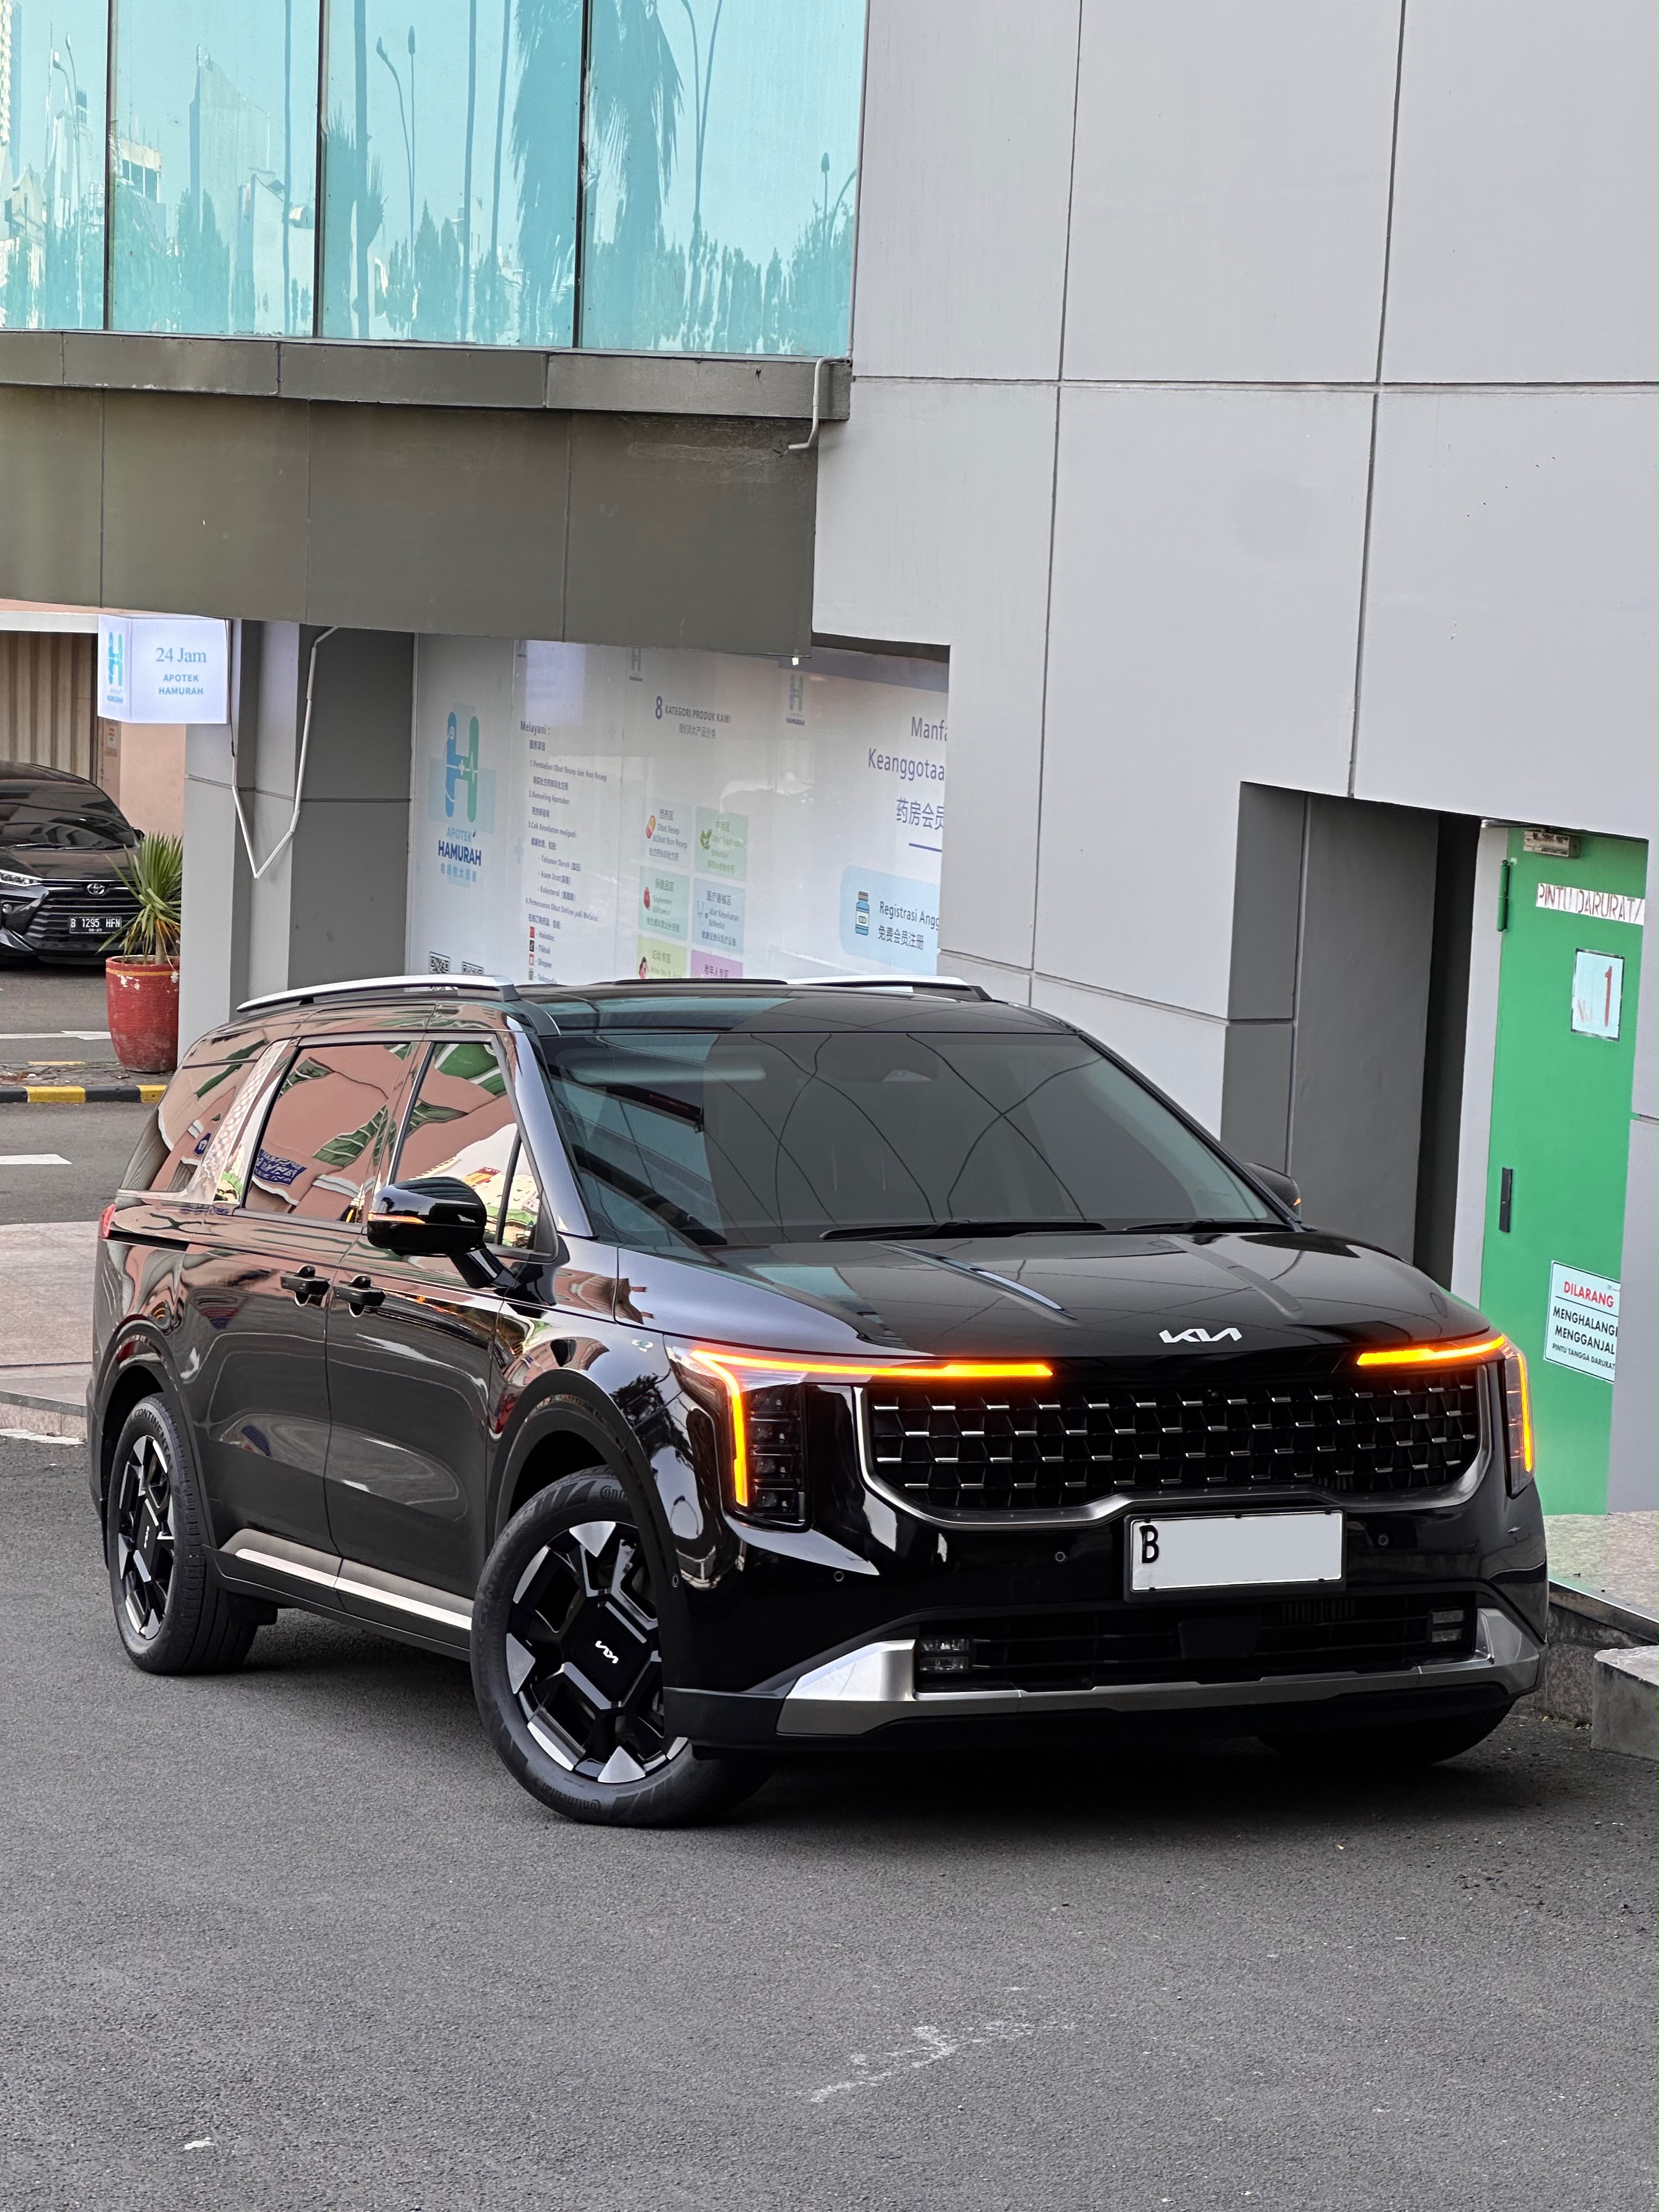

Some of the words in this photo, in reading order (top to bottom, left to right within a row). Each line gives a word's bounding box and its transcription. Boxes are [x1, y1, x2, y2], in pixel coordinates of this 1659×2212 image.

[155, 648, 173, 662] 24
[177, 648, 207, 662] Jam
[163, 674, 199, 682] APOTEK
[655, 695, 662, 719] 8
[664, 705, 691, 718] KATEGORI
[692, 709, 716, 722] PRODUK
[717, 713, 731, 724] KAMI
[520, 721, 546, 735] Melayani
[868, 748, 944, 781] Keanggotaa
[896, 797, 944, 830] 药房会员
[446, 827, 472, 842] APOTEK
[438, 840, 482, 866] HAMURAH
[1537, 883, 1572, 911] PINTU
[71, 918, 76, 928] B
[82, 918, 100, 928] 1295
[879, 901, 917, 922] Registrasi
[878, 924, 924, 950] 免费会员注册
[1604, 966, 1613, 1027] 1
[1563, 1281, 1614, 1308] DILARANG
[1159, 1327, 1243, 1343] KIA
[1554, 1325, 1615, 1355] MENGGANJAL
[1552, 1343, 1567, 1353] PINTU
[1568, 1348, 1590, 1361] TANGGA
[1590, 1356, 1615, 1370] DARURAT
[1140, 1525, 1159, 1564] B
